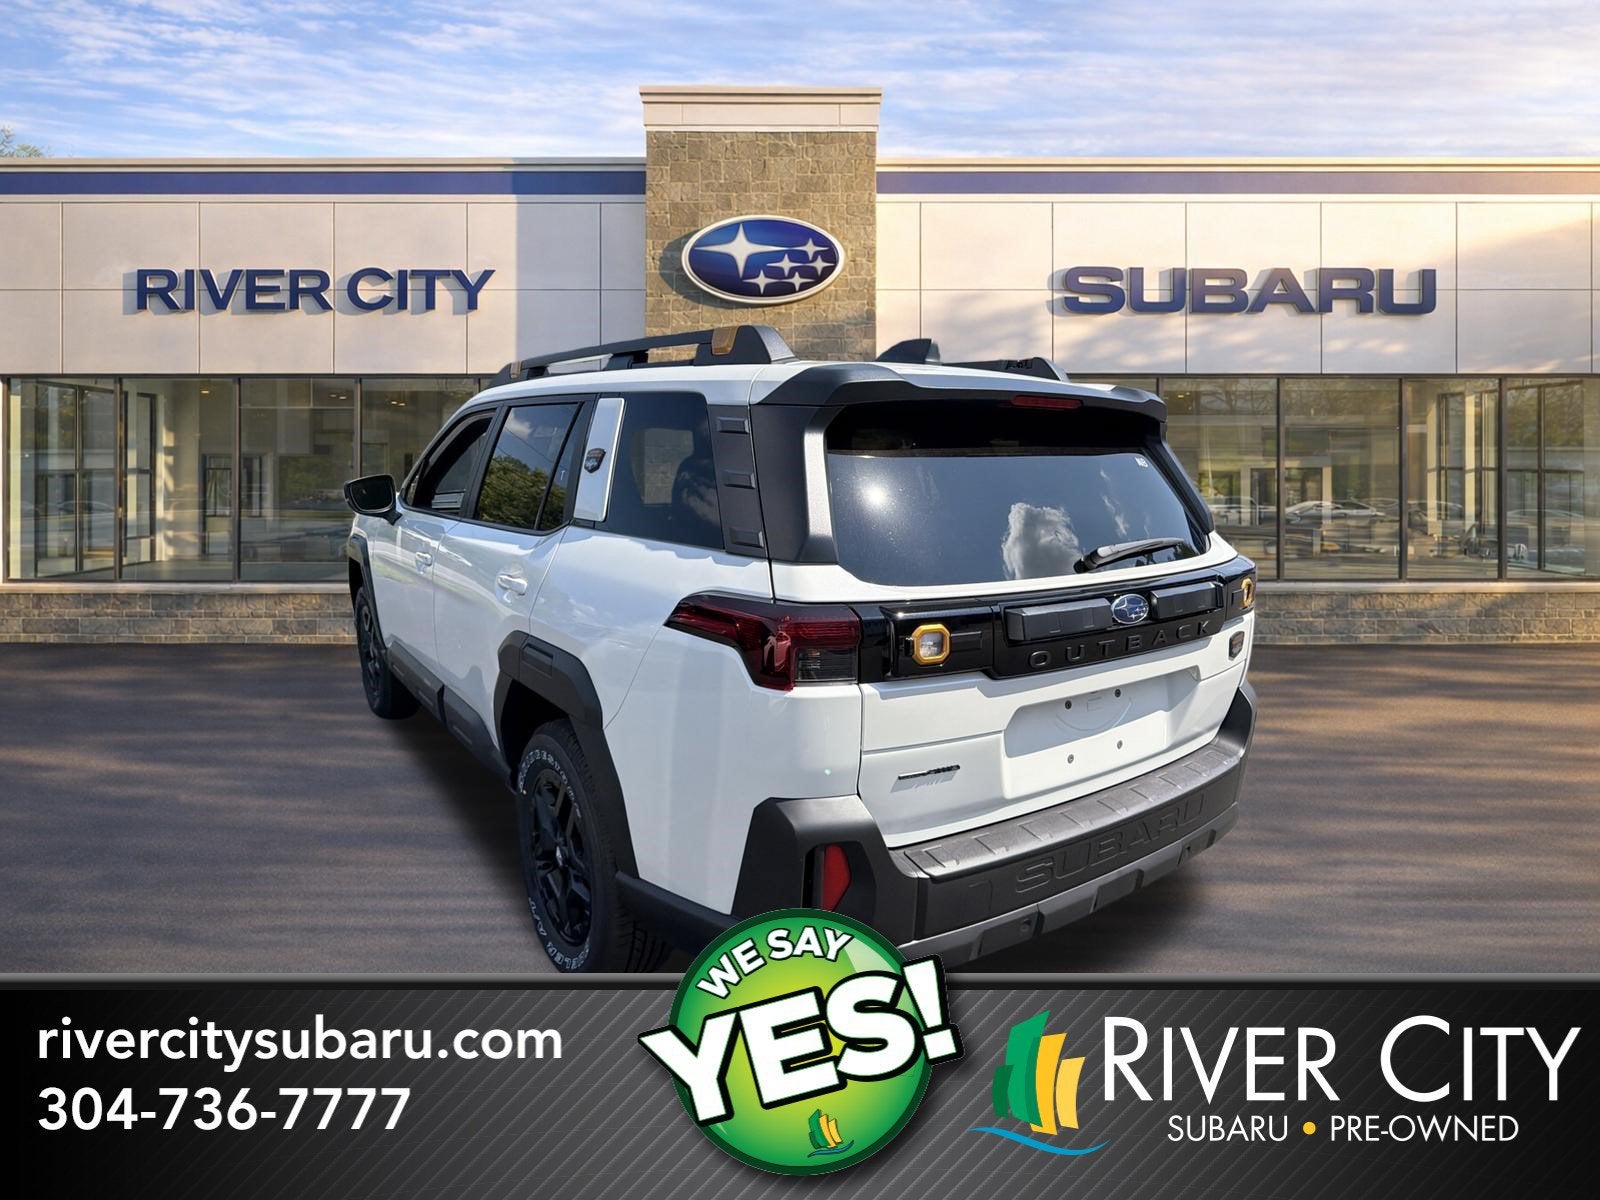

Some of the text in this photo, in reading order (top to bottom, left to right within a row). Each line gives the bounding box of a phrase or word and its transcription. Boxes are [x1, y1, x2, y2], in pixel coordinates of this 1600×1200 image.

[136, 267, 496, 312] RIVER CITY
[1062, 266, 1437, 315] SUBARU
[1029, 619, 1212, 668] OUTBACK
[1015, 794, 1208, 896] SUBARU
